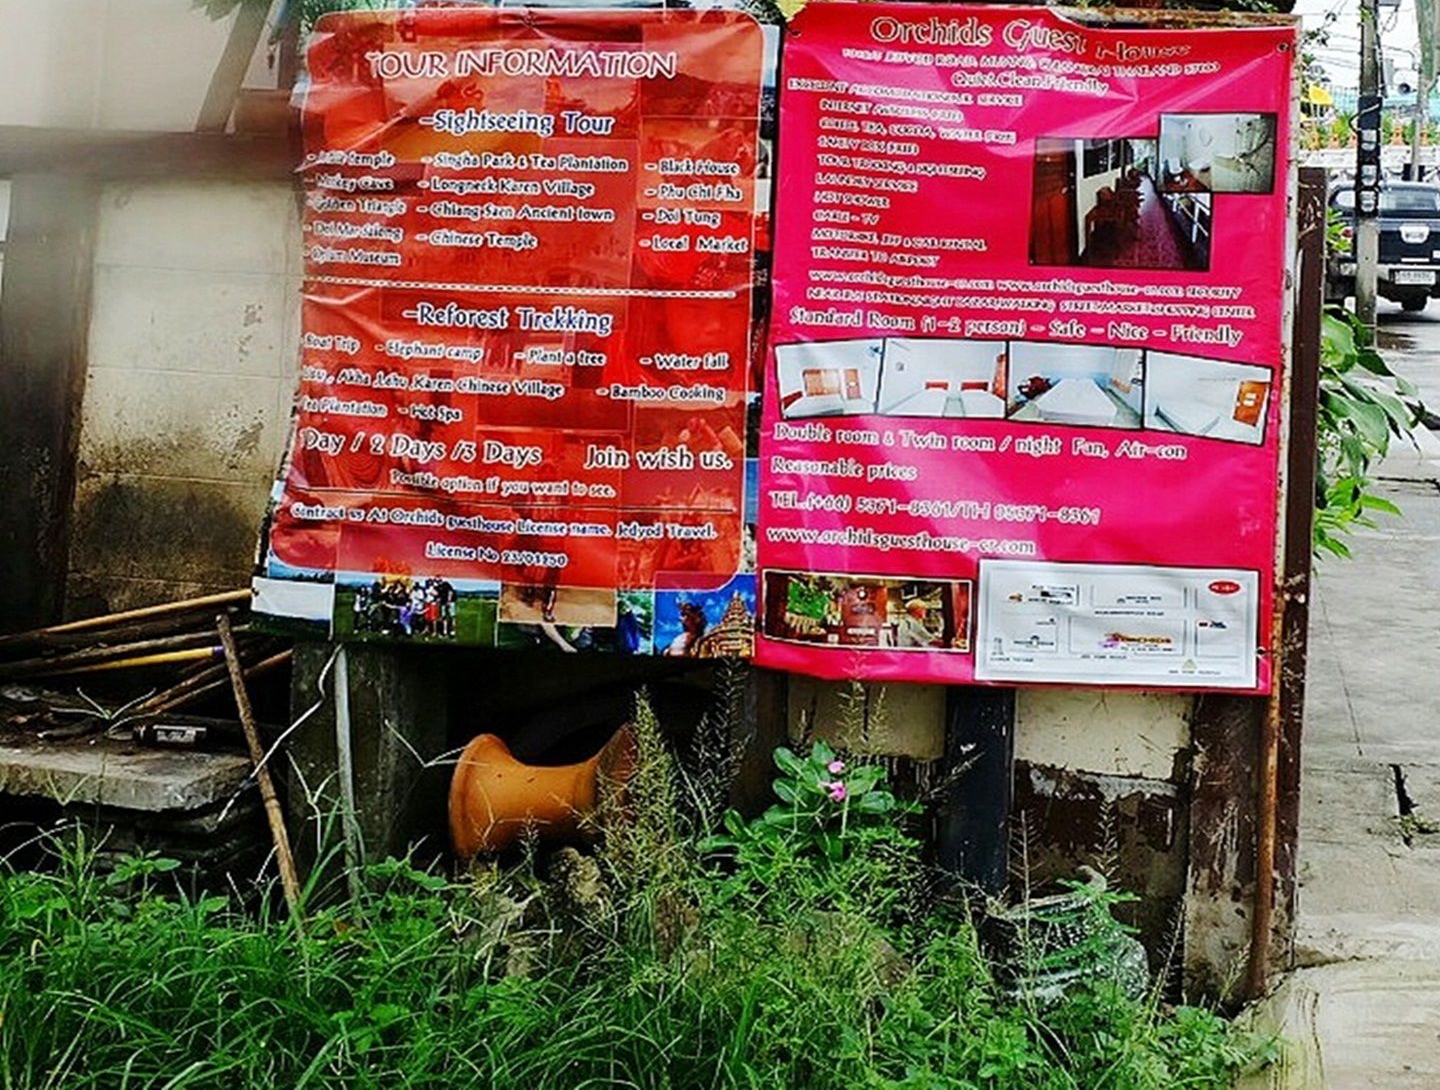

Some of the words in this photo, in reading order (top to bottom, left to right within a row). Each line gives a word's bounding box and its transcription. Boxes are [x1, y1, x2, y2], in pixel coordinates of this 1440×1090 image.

[871, 17, 993, 47] Orchids
[1002, 18, 1086, 54] Guest
[365, 50, 448, 78] TOUR
[456, 49, 677, 78] INFORMATION
[560, 111, 615, 134] Tour
[431, 177, 496, 195] Longneck
[543, 181, 595, 198] Village
[485, 233, 538, 250] Temple
[696, 237, 750, 253] Market
[518, 306, 612, 336] Trekking
[789, 306, 862, 327] Standard
[866, 311, 915, 331] Room
[1048, 319, 1086, 339] Safe
[1107, 321, 1149, 340] Nice
[1170, 323, 1244, 347] Friendly
[654, 354, 700, 369] Water
[513, 380, 565, 400] Village
[299, 427, 345, 456] Day
[369, 435, 386, 454] 2
[391, 434, 445, 460] Days
[484, 441, 543, 468] Days
[773, 423, 831, 442] Double
[835, 429, 880, 447] room
[900, 429, 948, 449] Twin
[951, 434, 996, 451] room
[1015, 435, 1062, 459] night
[584, 444, 630, 470] Join
[636, 444, 694, 470] wish
[701, 450, 733, 470] us.
[770, 456, 864, 478] Reasonable
[866, 461, 918, 481] prices
